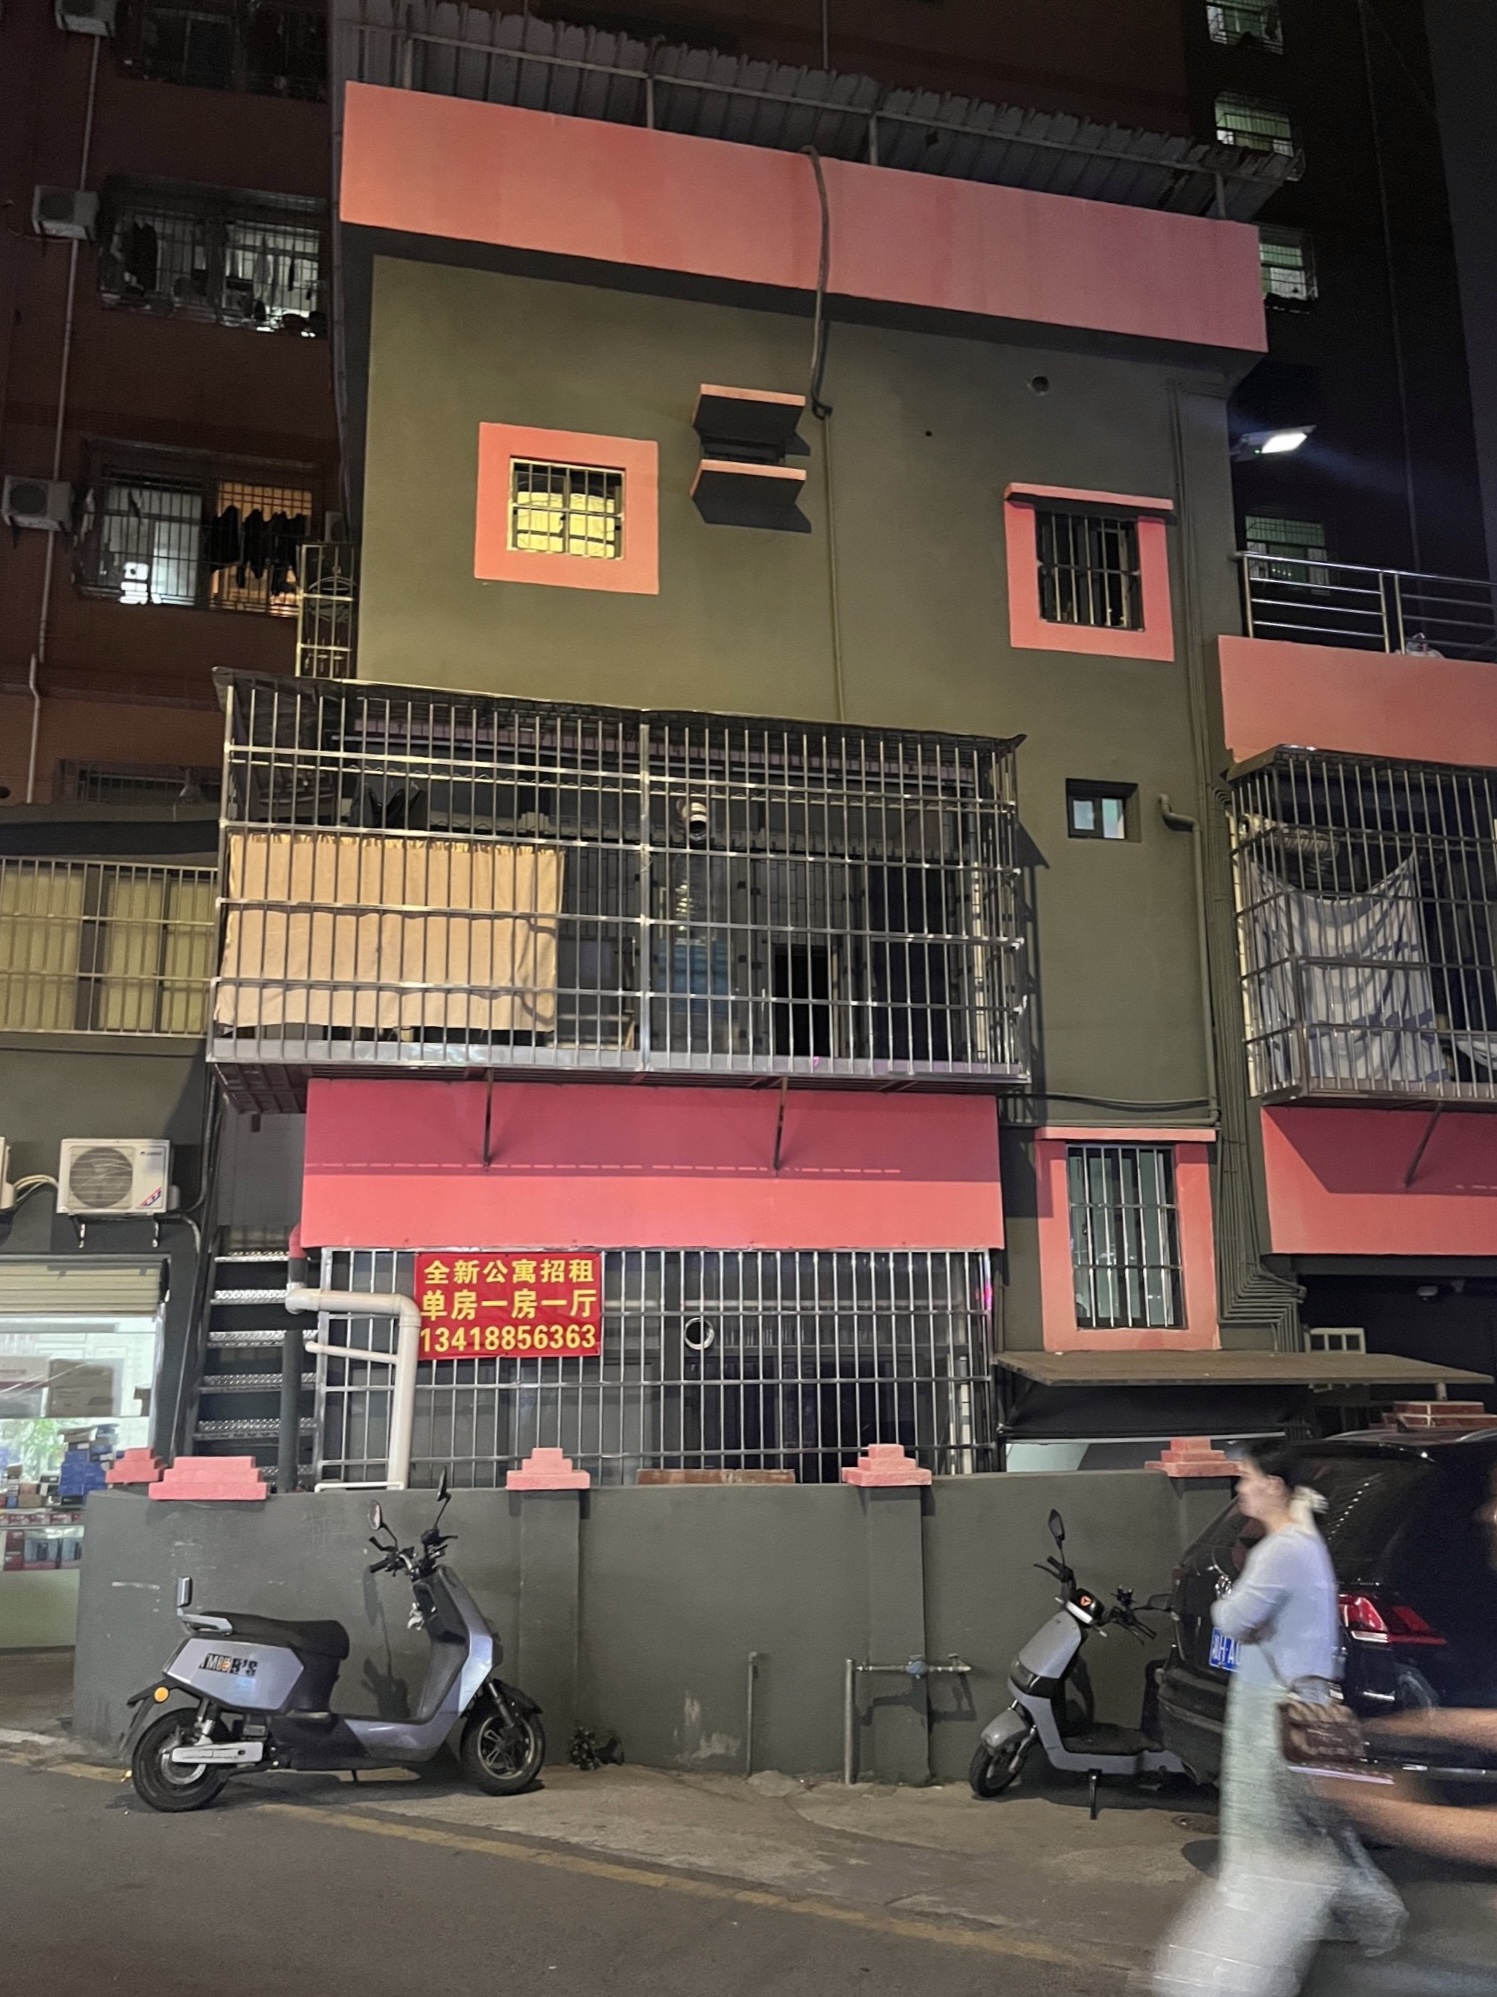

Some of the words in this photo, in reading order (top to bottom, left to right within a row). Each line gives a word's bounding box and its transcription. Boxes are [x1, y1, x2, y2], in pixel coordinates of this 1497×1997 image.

[424, 1259, 595, 1285] 全新公寓招租
[420, 1288, 597, 1322] 单房一房一厅
[420, 1324, 596, 1353] 13418856363
